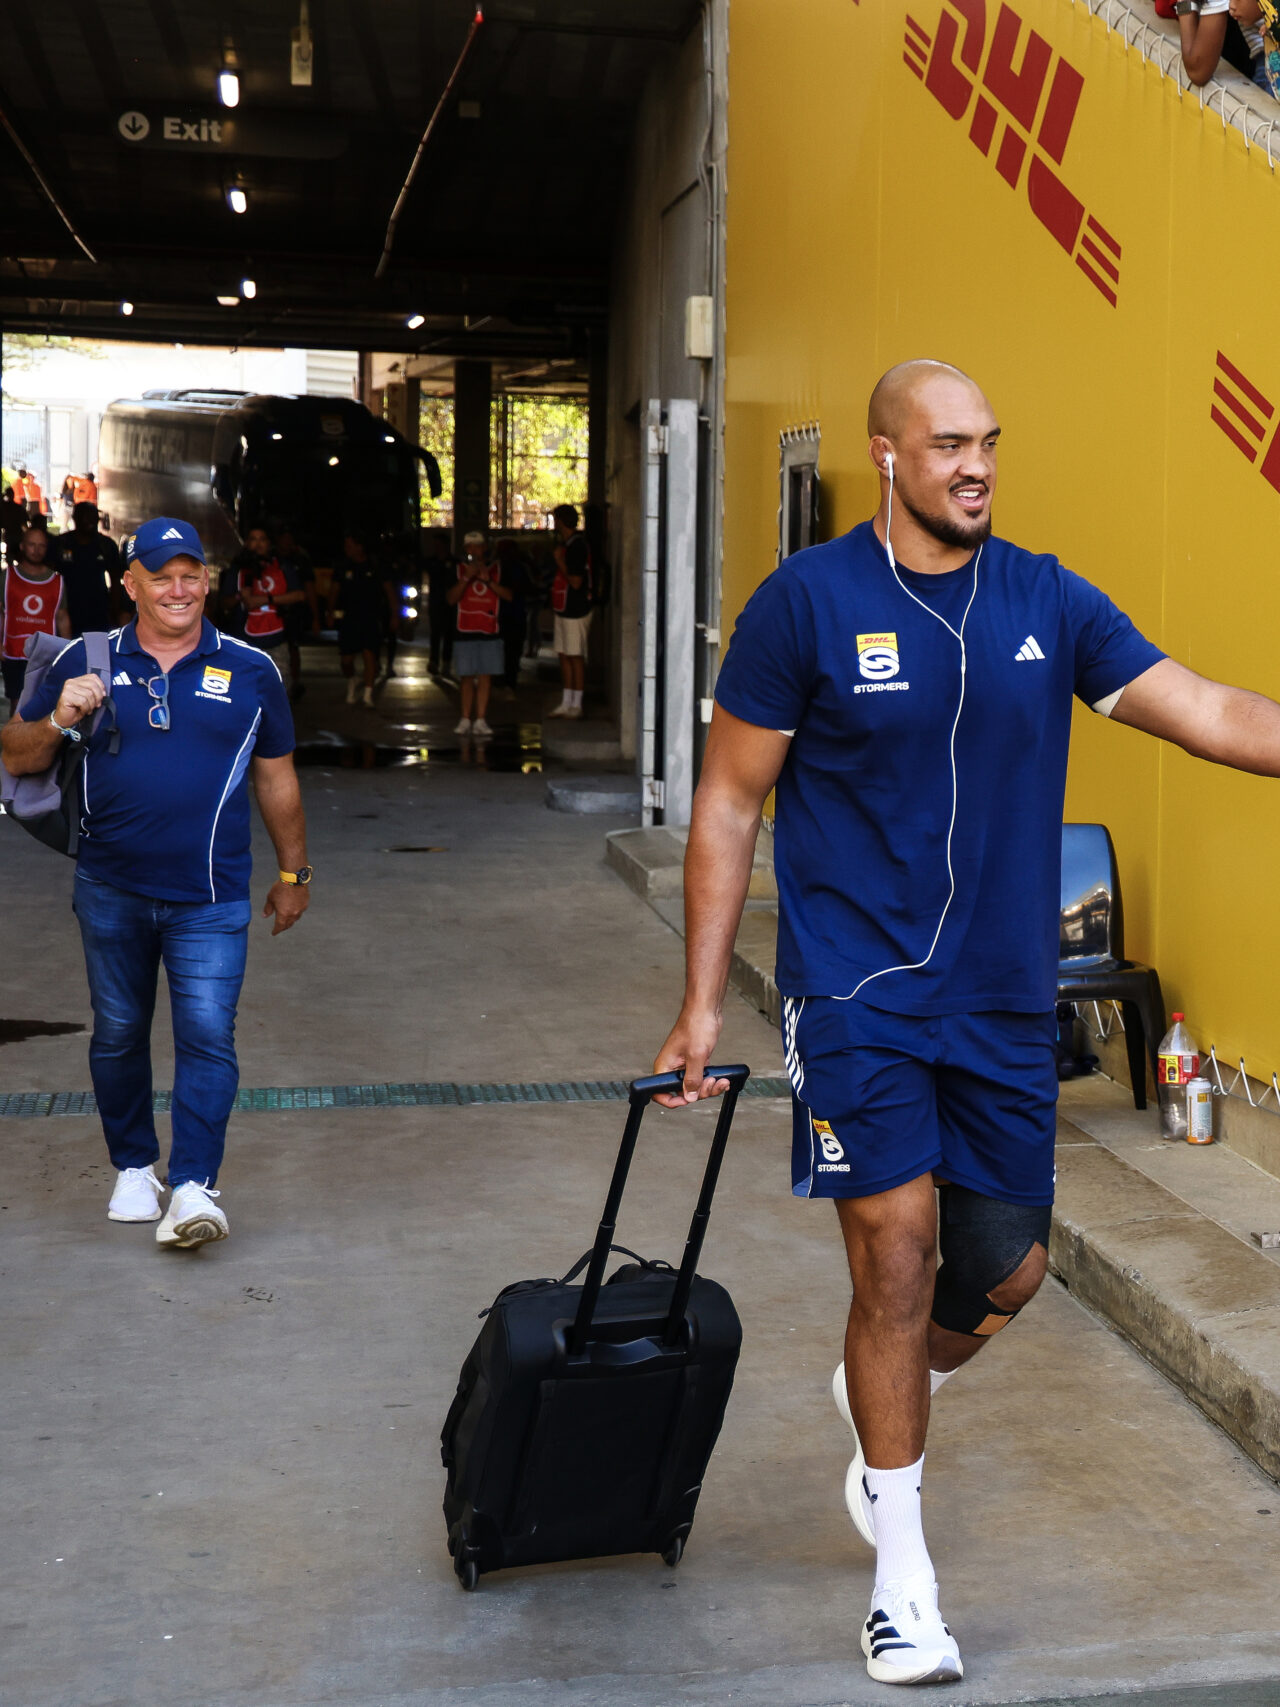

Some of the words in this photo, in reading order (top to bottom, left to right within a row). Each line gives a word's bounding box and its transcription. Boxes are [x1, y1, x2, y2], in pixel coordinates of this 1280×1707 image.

[163, 117, 222, 142] Exit
[925, 0, 1086, 255] DHL
[864, 636, 890, 645] DHL
[853, 681, 910, 694] STORMERS
